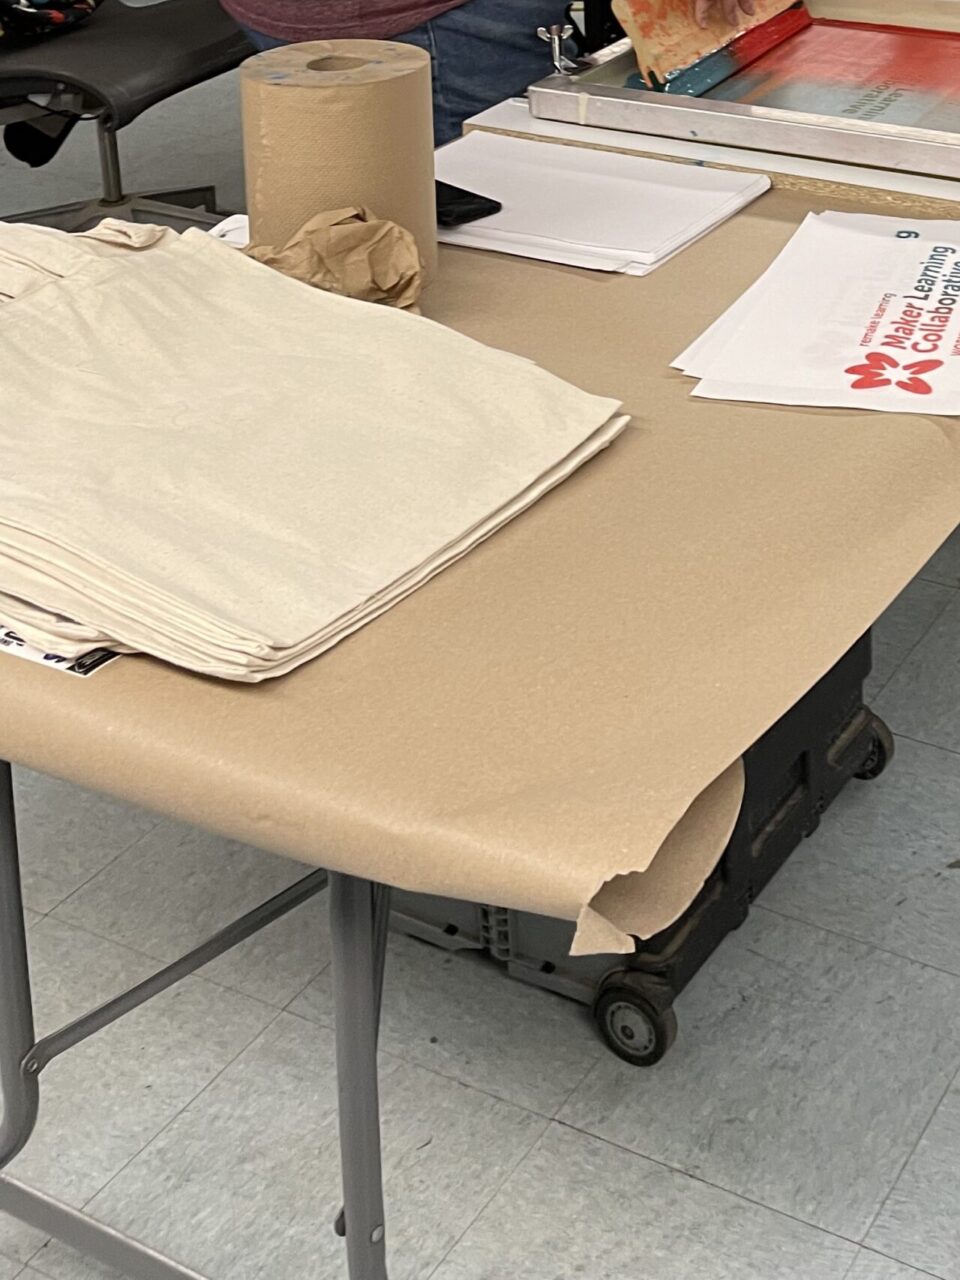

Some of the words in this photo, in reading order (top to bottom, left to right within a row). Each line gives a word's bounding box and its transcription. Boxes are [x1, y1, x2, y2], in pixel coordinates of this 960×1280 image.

[902, 245, 957, 302] Learning
[859, 320, 881, 347] remake
[870, 292, 897, 320] learning
[880, 302, 925, 350] Maker
